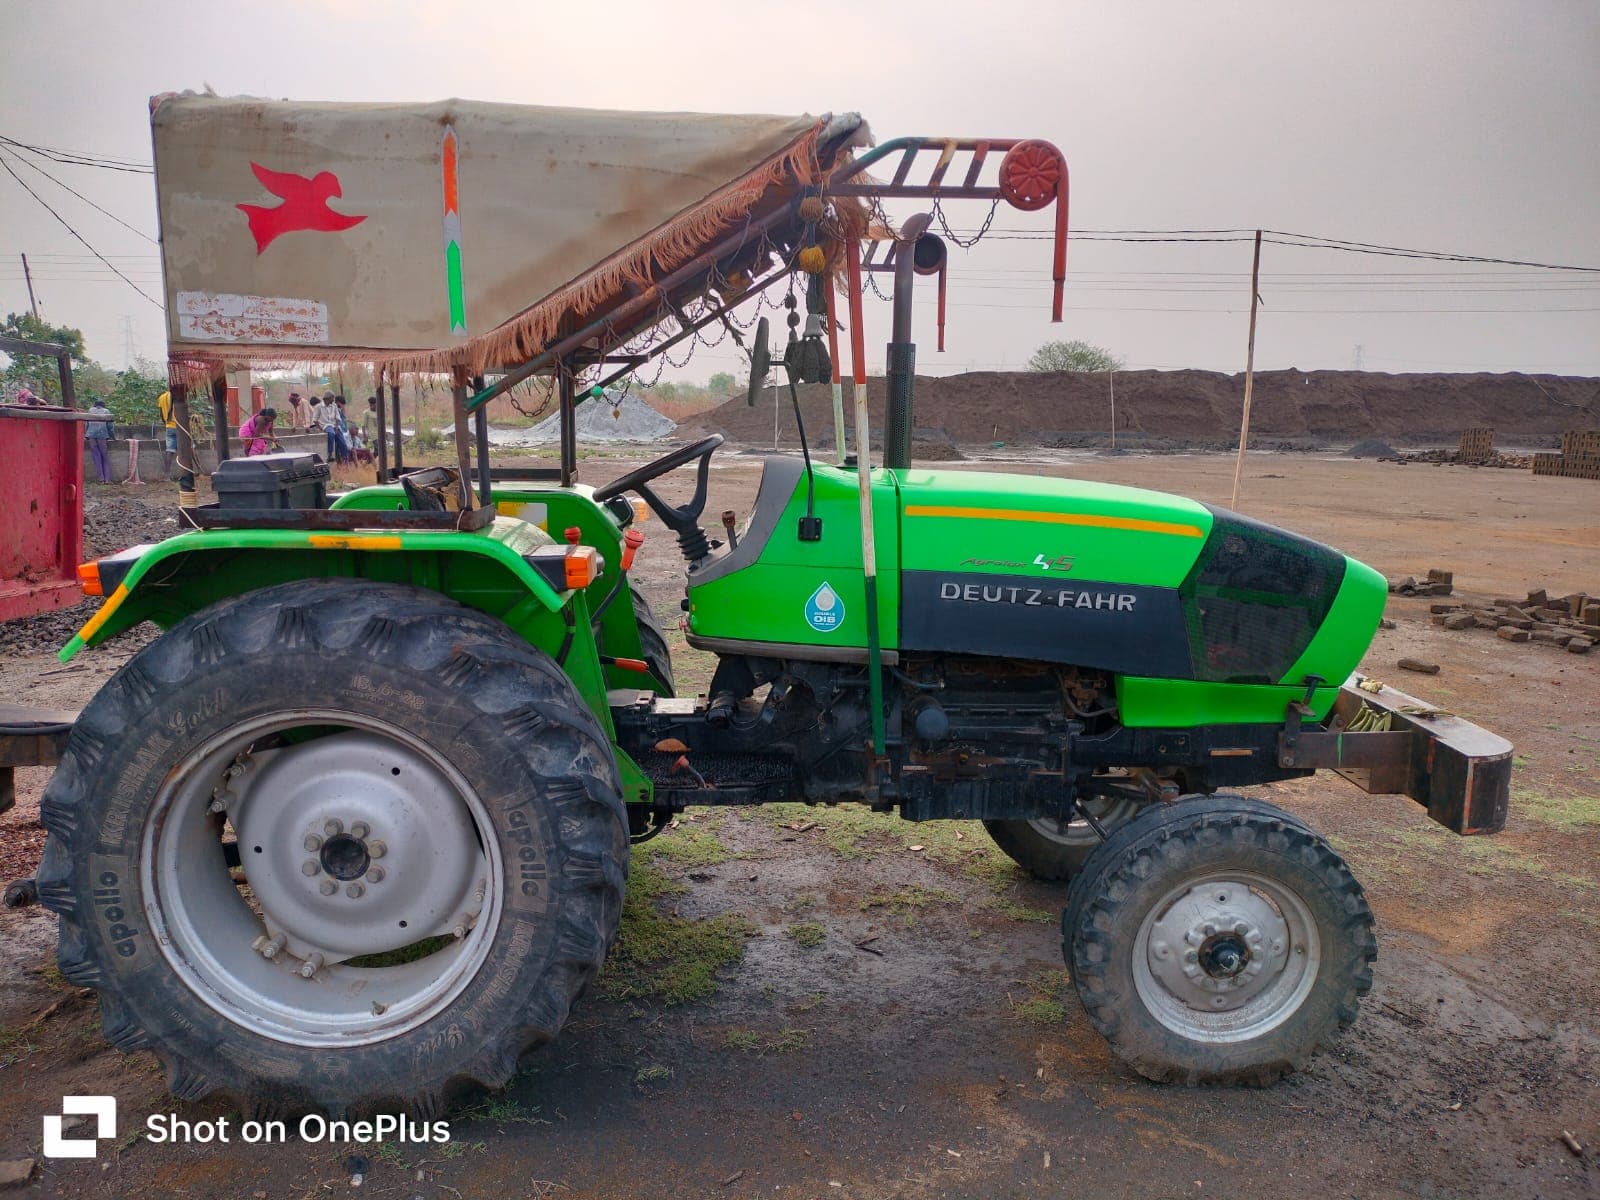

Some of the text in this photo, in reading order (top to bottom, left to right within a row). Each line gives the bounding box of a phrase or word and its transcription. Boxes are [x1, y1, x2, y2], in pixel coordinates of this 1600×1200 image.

[1033, 553, 1076, 572] 45
[940, 582, 1137, 612] DEUTZ-FAHR
[93, 870, 139, 957] apollo
